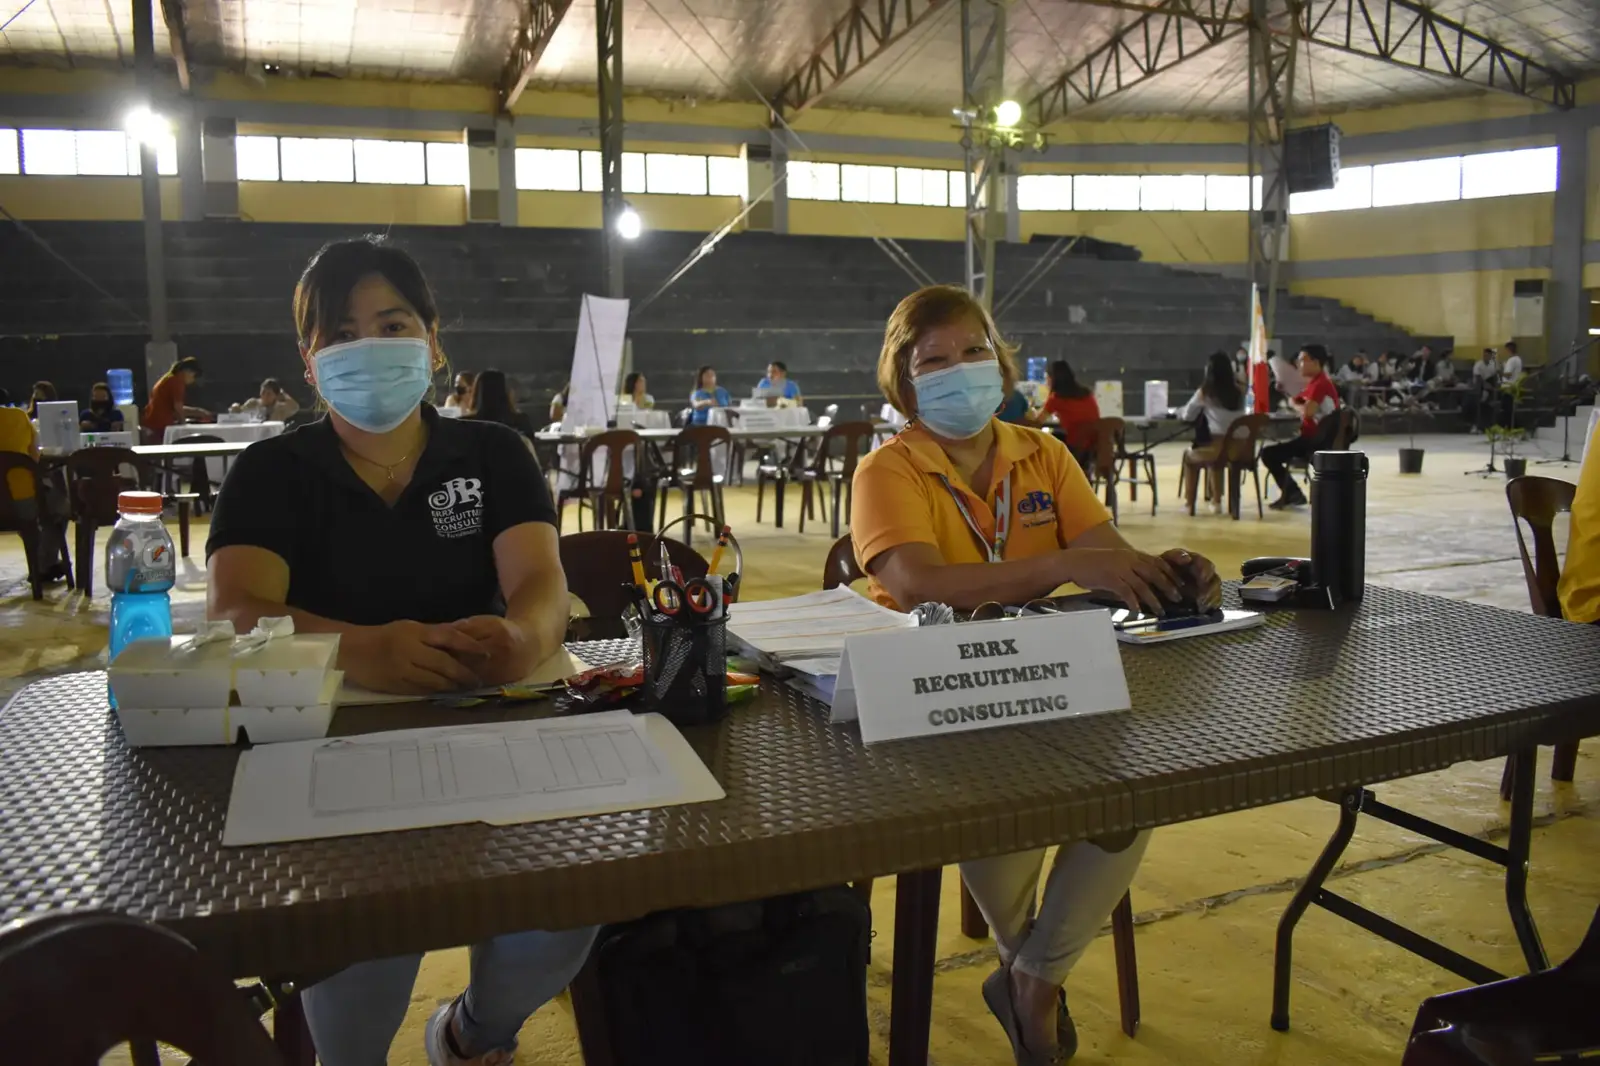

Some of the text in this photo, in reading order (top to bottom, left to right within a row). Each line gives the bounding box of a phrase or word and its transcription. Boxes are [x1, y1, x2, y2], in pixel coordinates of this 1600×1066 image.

[957, 639, 1020, 660] ERRX
[913, 662, 1070, 695] RECRUITMENT
[928, 694, 1069, 727] CONSULTING
